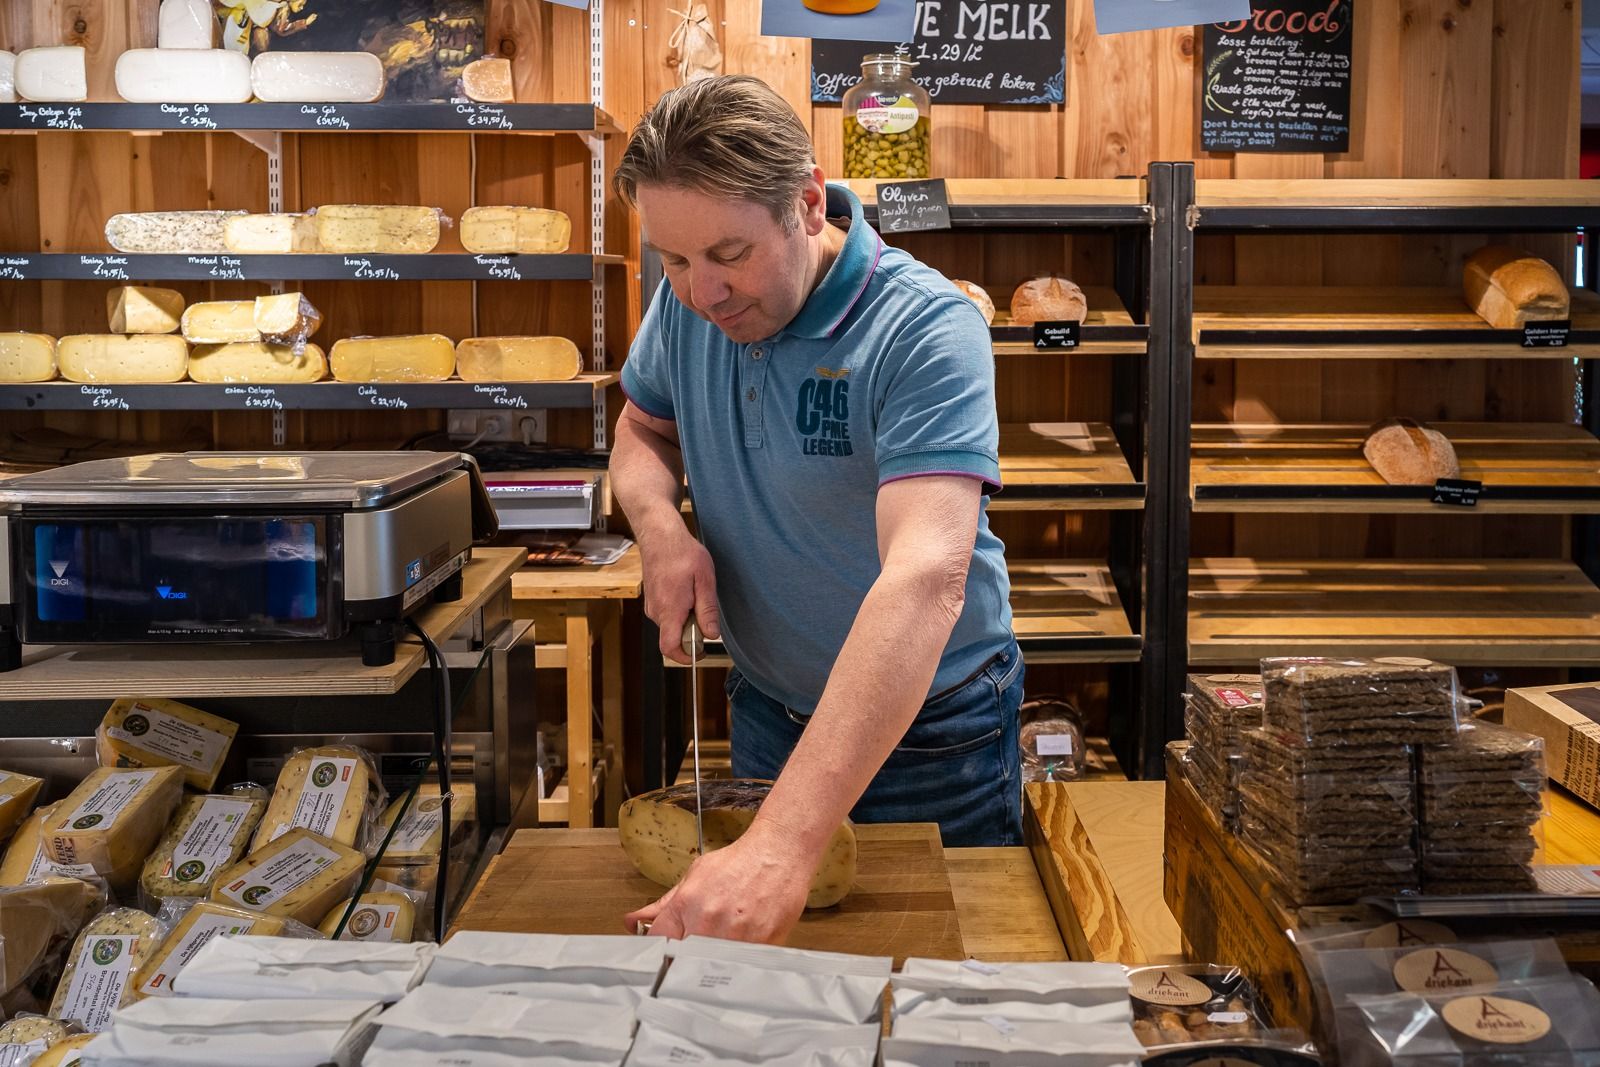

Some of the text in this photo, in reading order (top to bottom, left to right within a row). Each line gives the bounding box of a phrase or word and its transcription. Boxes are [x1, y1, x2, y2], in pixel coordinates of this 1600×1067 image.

[954, 3, 1051, 41] MELK
[1217, 35, 1246, 47] Losse
[929, 71, 993, 97] gebruik
[1000, 74, 1036, 92] koken
[796, 377, 849, 436] C46
[821, 420, 850, 440] PME
[802, 438, 854, 457] LEGEND
[51, 578, 69, 586] DIGI
[90, 969, 107, 1007] Brandnetel
[114, 982, 121, 991] De
